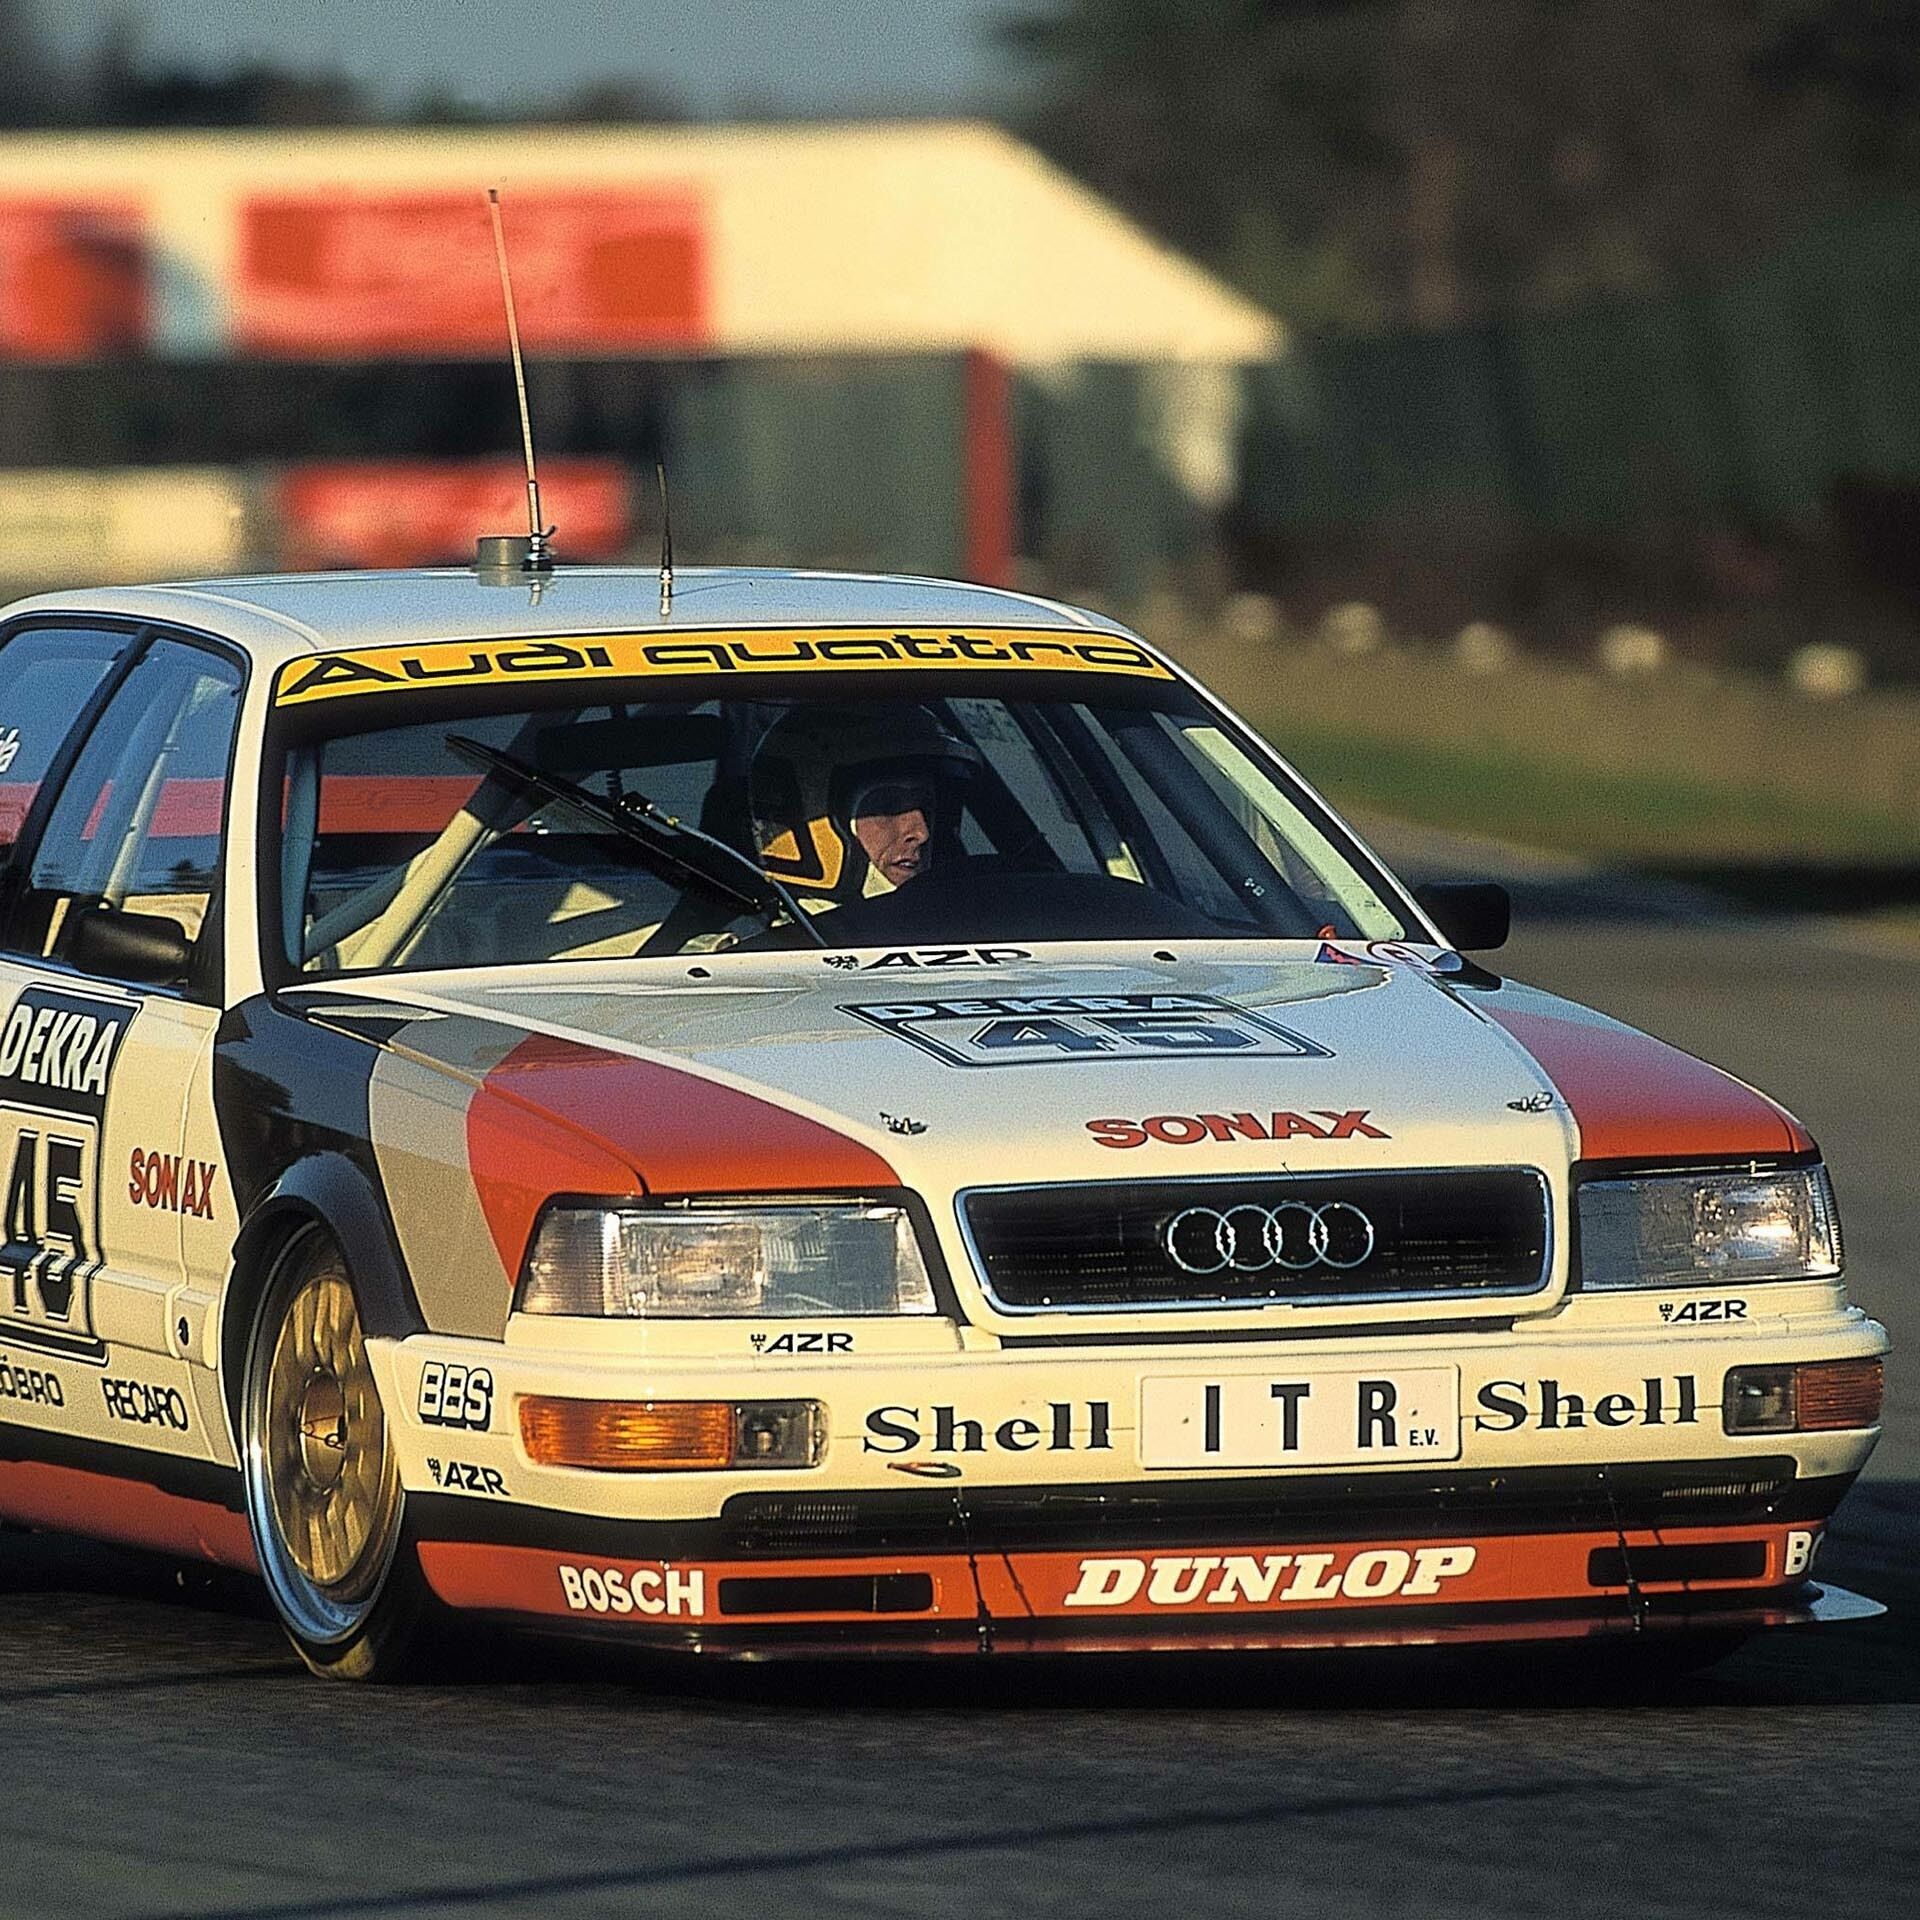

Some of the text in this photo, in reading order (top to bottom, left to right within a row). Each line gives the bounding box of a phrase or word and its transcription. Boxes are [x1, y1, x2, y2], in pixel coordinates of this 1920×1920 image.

[284, 631, 1158, 697] Audi quattro
[859, 996, 1225, 1020] DEKRA
[0, 1004, 120, 1095] DEKRA
[969, 1015, 1261, 1056] 45
[1086, 1110, 1391, 1148] SONAX
[129, 1148, 217, 1220] SONAX
[1672, 1301, 1748, 1323] AZR
[764, 1332, 854, 1354] AZR
[101, 1377, 189, 1432] RECARO
[417, 1361, 494, 1431] BBS
[1474, 1375, 1700, 1434] Shell
[863, 1401, 1114, 1453] Shell
[1409, 1429, 1440, 1448] E.V.
[443, 1461, 511, 1497] AZR
[558, 1564, 705, 1618] BOSCH
[1064, 1546, 1477, 1606] DUNLOP
